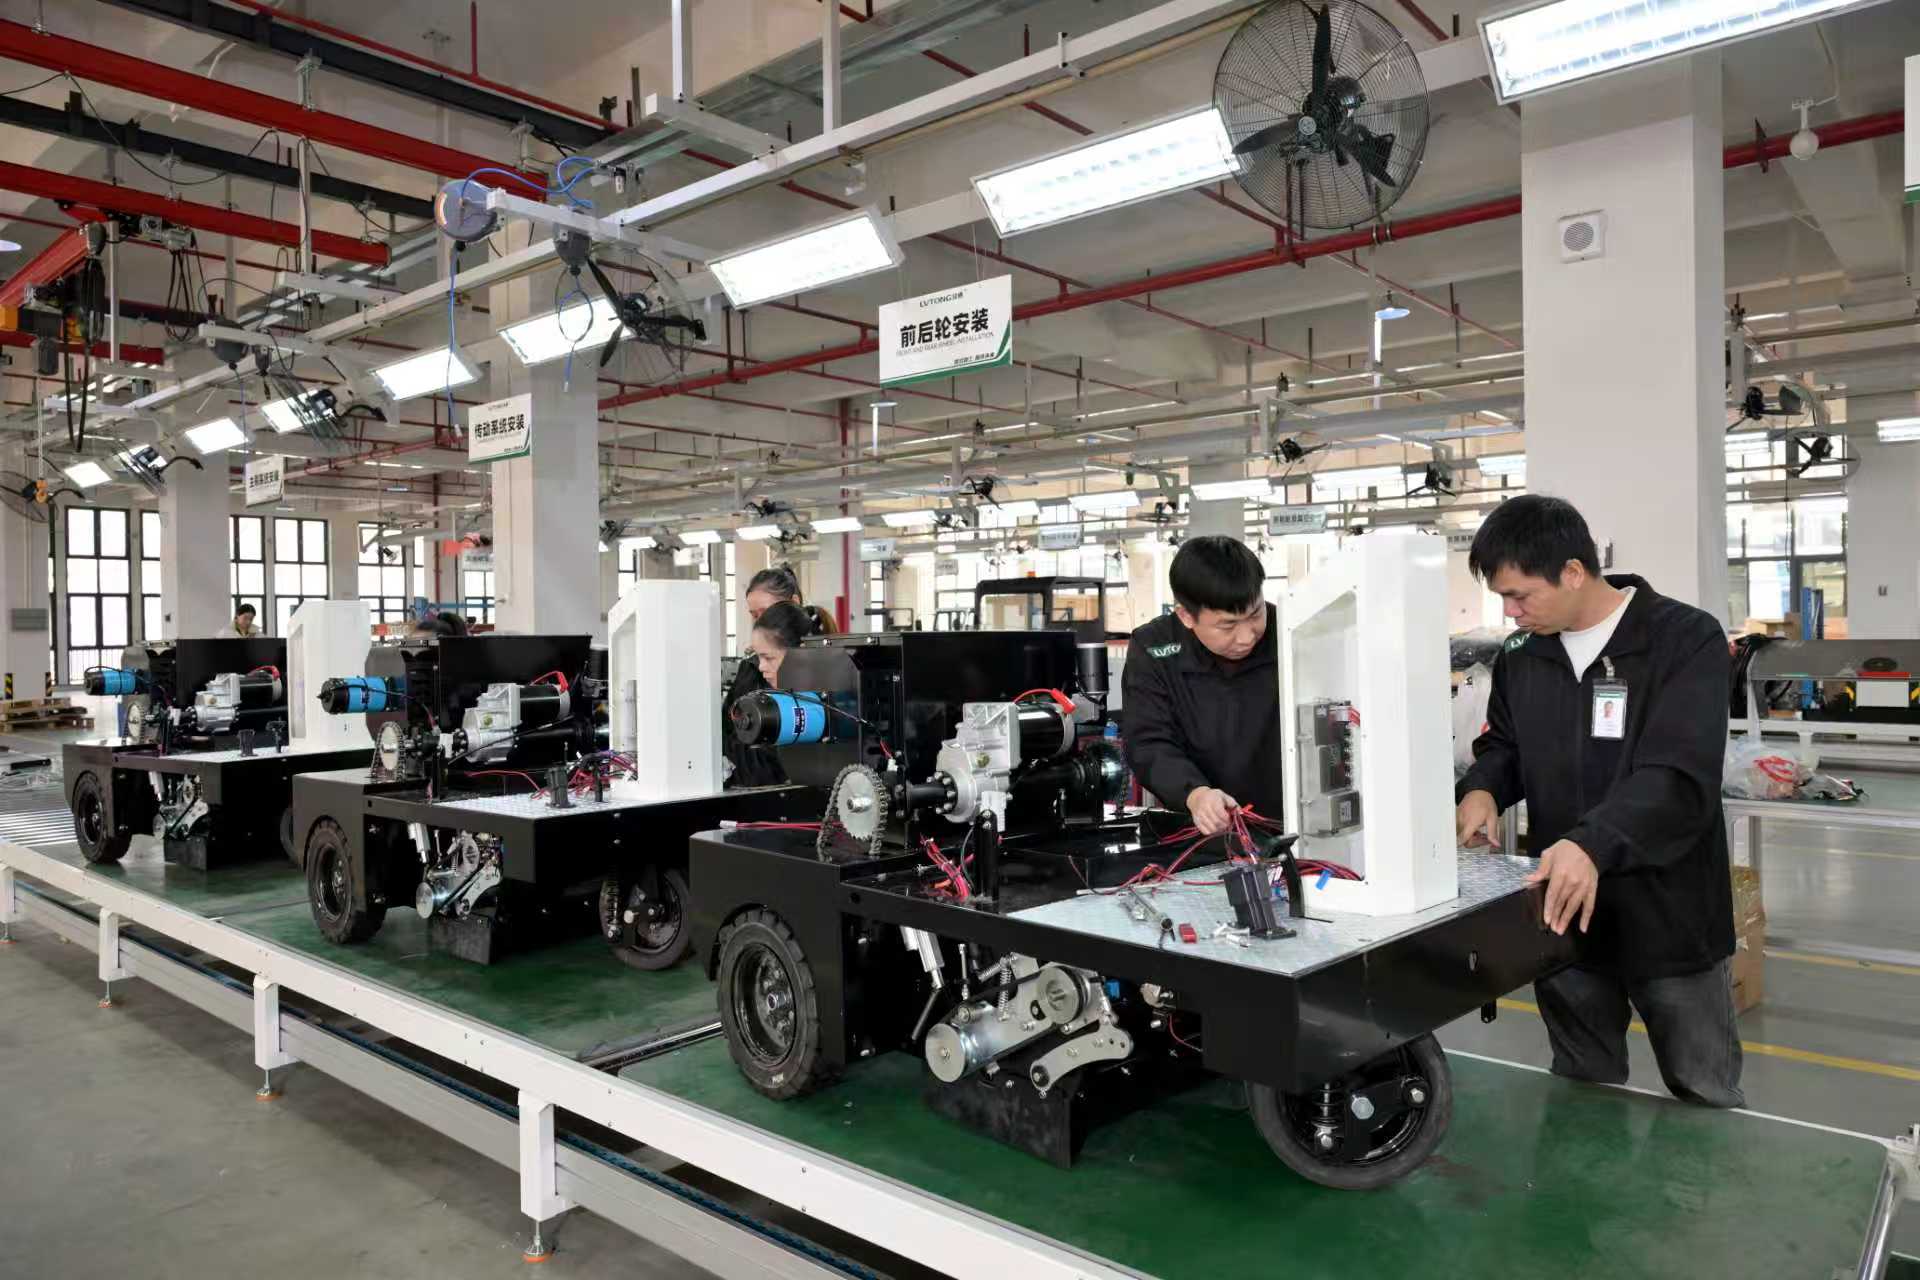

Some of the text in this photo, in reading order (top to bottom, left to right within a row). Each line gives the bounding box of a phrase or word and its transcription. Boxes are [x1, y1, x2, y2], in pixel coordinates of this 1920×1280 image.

[900, 307, 989, 349] 前后轮安装
